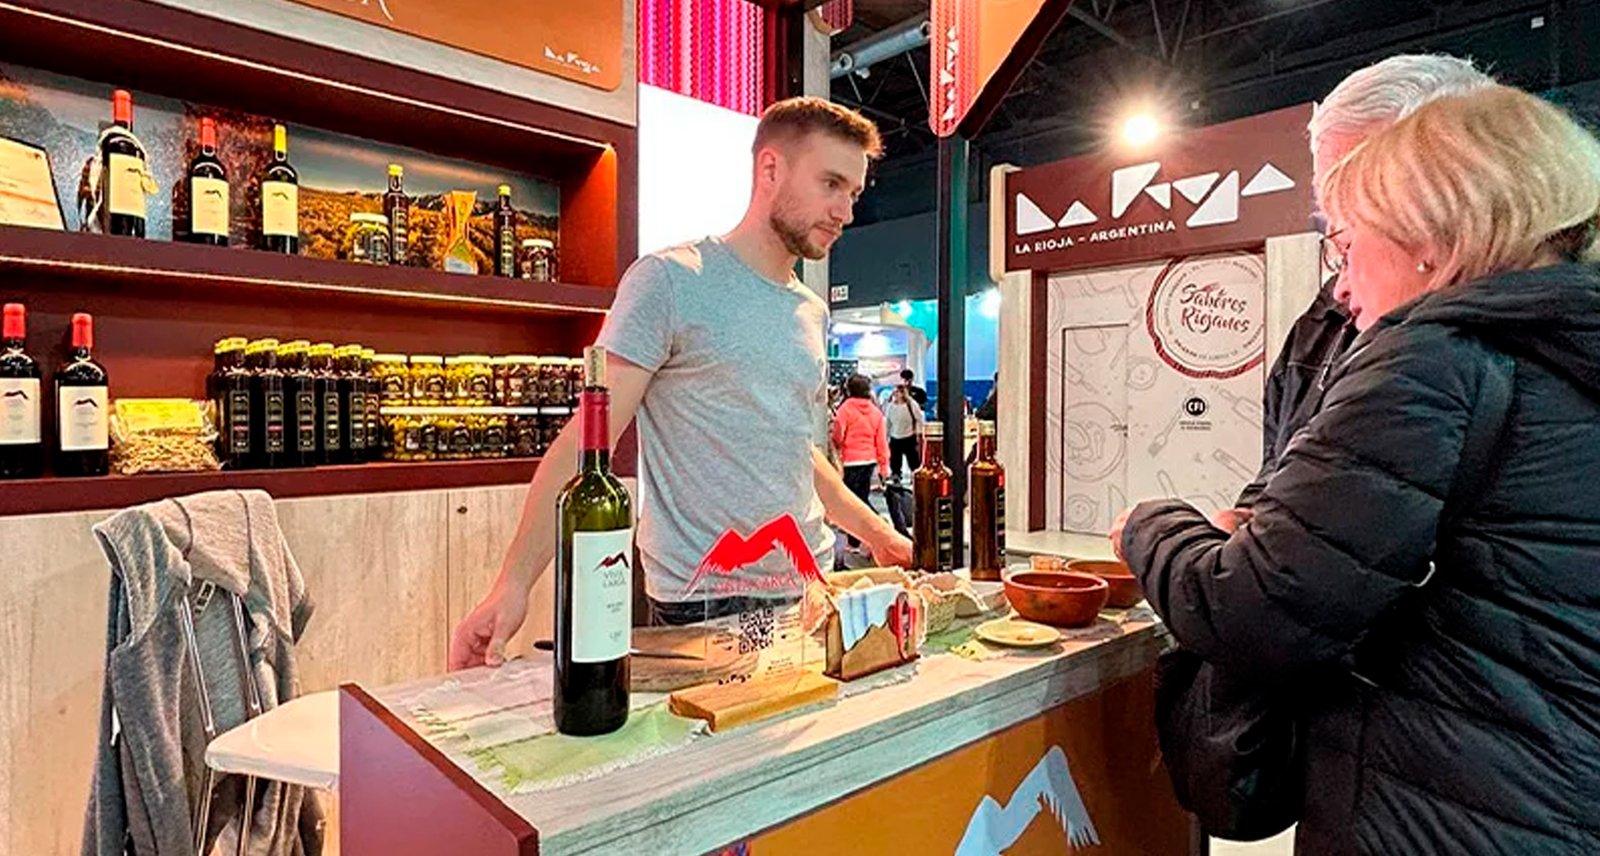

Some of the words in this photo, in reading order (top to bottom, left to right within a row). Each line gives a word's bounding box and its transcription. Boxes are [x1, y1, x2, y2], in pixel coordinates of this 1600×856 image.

[1015, 243, 1031, 254] LA
[1034, 237, 1074, 252] RIOJA
[1089, 220, 1176, 242] ARGENTINA
[1180, 282, 1247, 313] Sabores
